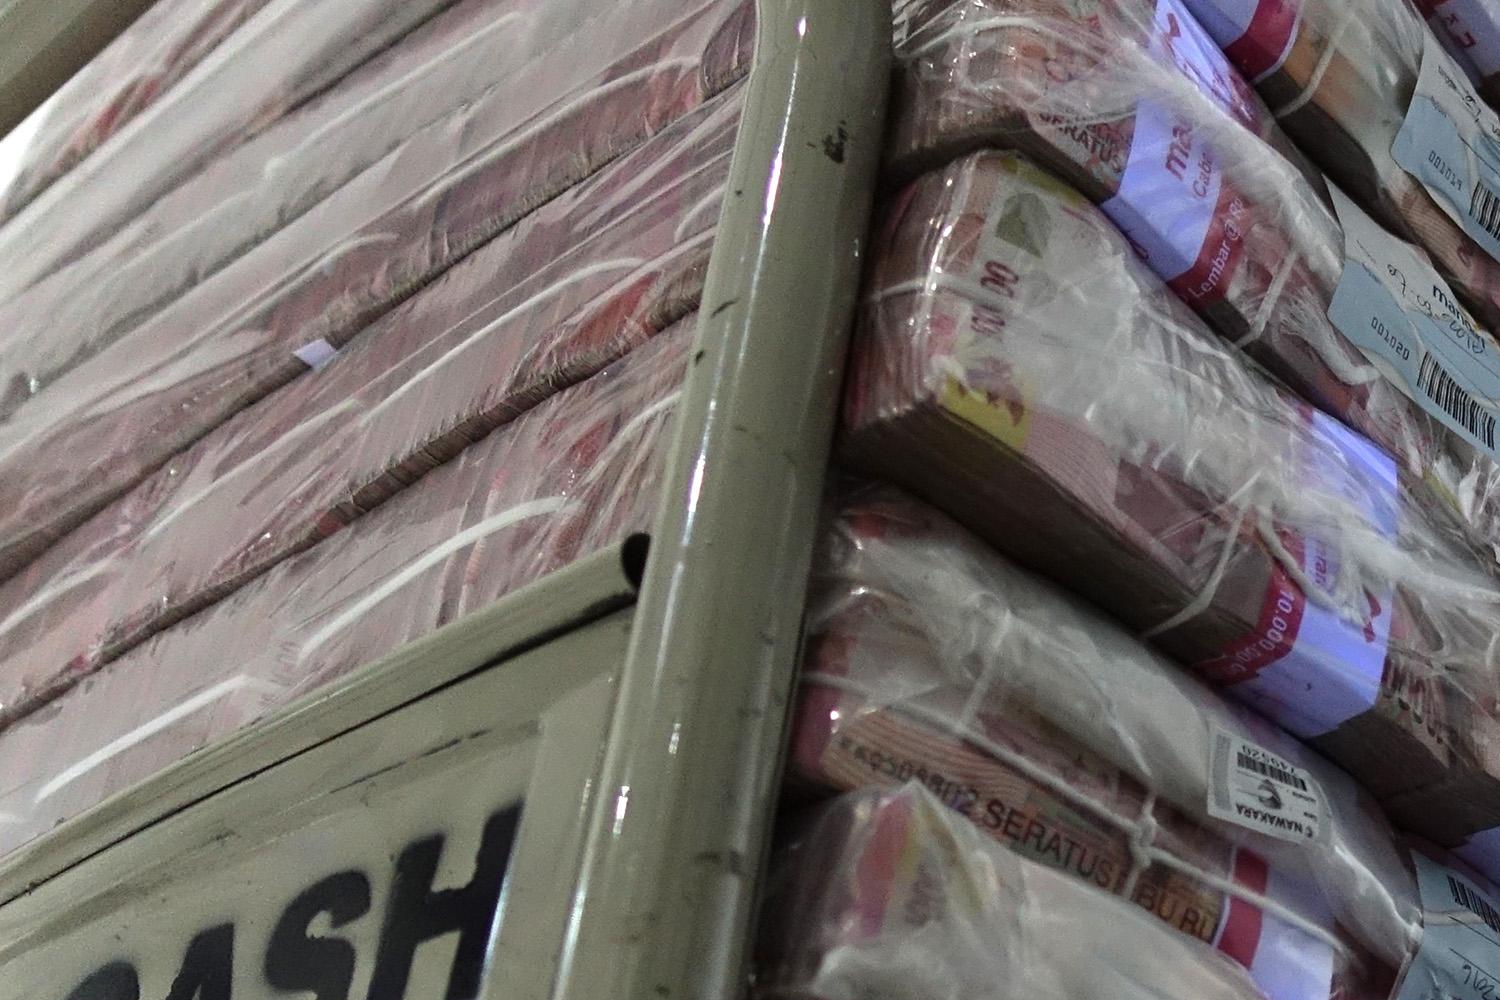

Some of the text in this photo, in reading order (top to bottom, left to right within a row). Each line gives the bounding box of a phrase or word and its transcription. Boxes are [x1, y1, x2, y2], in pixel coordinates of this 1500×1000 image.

[1371, 316, 1411, 361] 001020
[1236, 803, 1304, 834] NAWAKARA
[983, 797, 1116, 887] SERATUS
